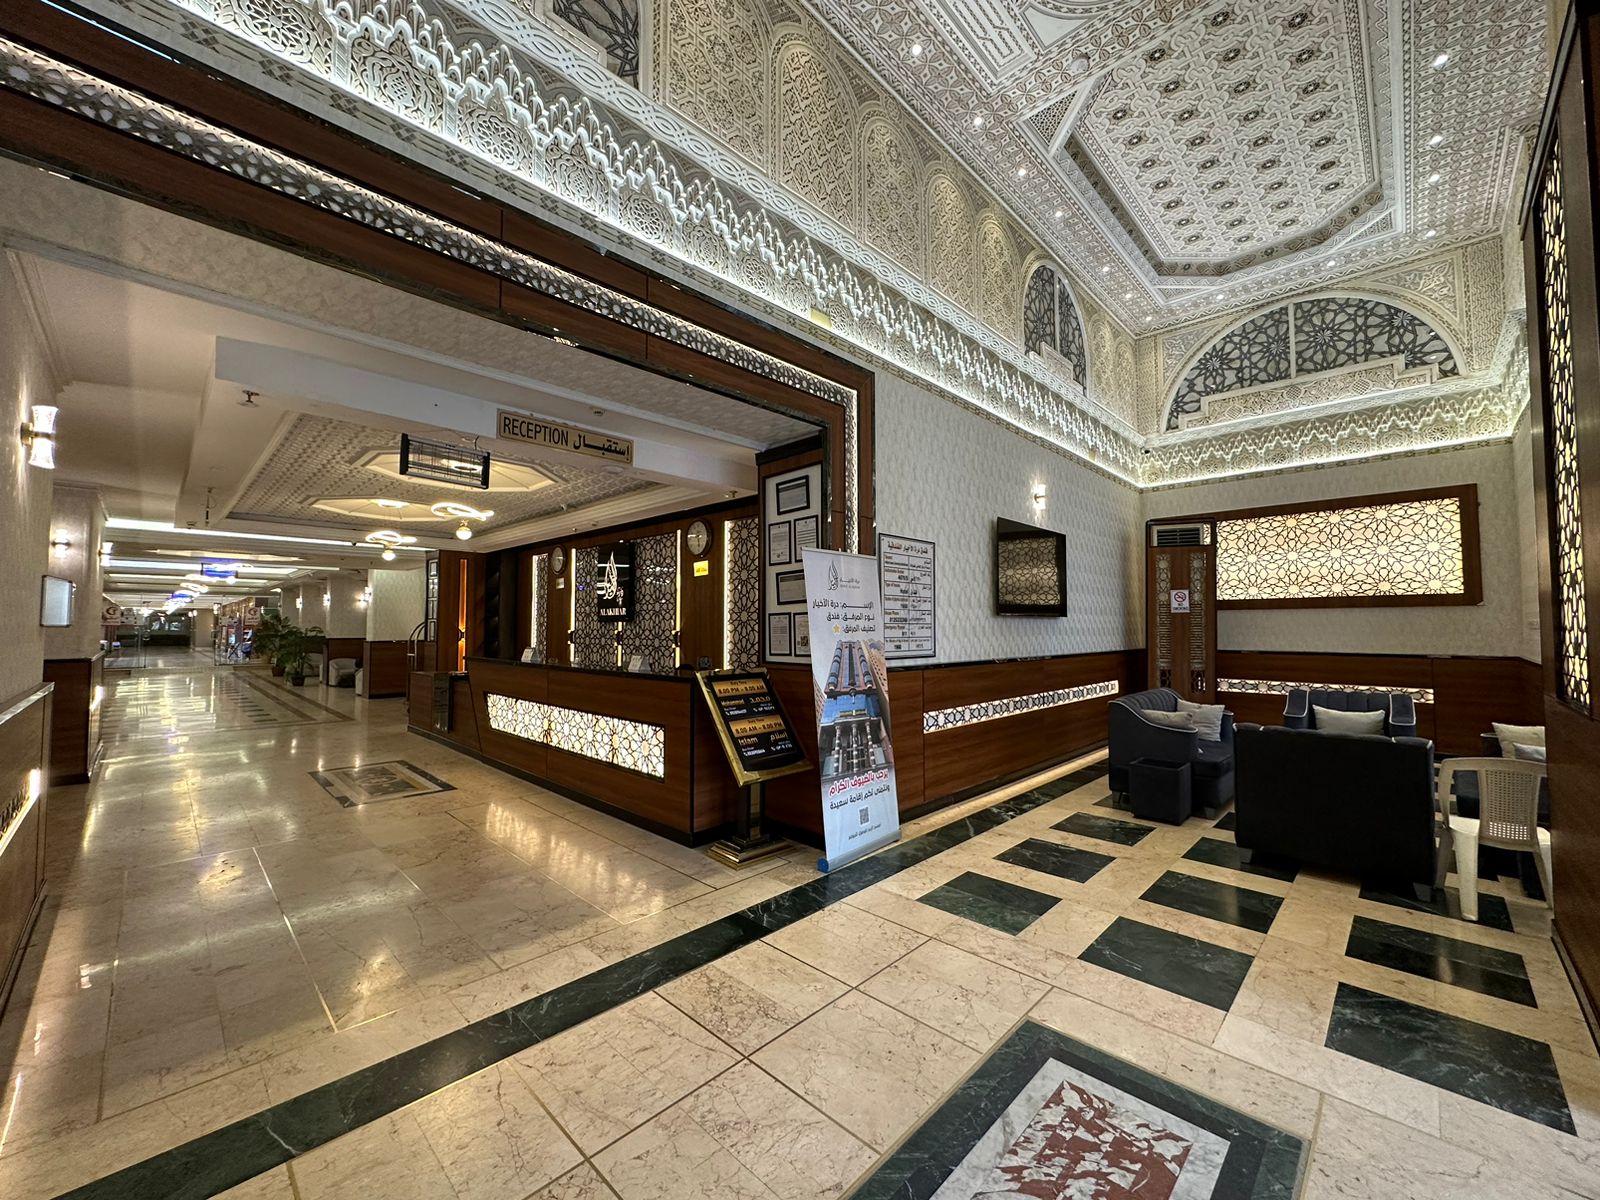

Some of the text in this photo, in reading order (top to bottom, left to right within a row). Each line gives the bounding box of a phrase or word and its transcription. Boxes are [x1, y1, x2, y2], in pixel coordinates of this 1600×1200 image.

[503, 416, 568, 446] RECEPTION
[830, 600, 839, 609] درة
[826, 611, 840, 621] فندق
[738, 736, 759, 746] Islam
[850, 771, 875, 787] بالضيوف
[829, 780, 850, 796] الكرام
[863, 788, 873, 800] لكم
[829, 798, 848, 810] سعيدة
